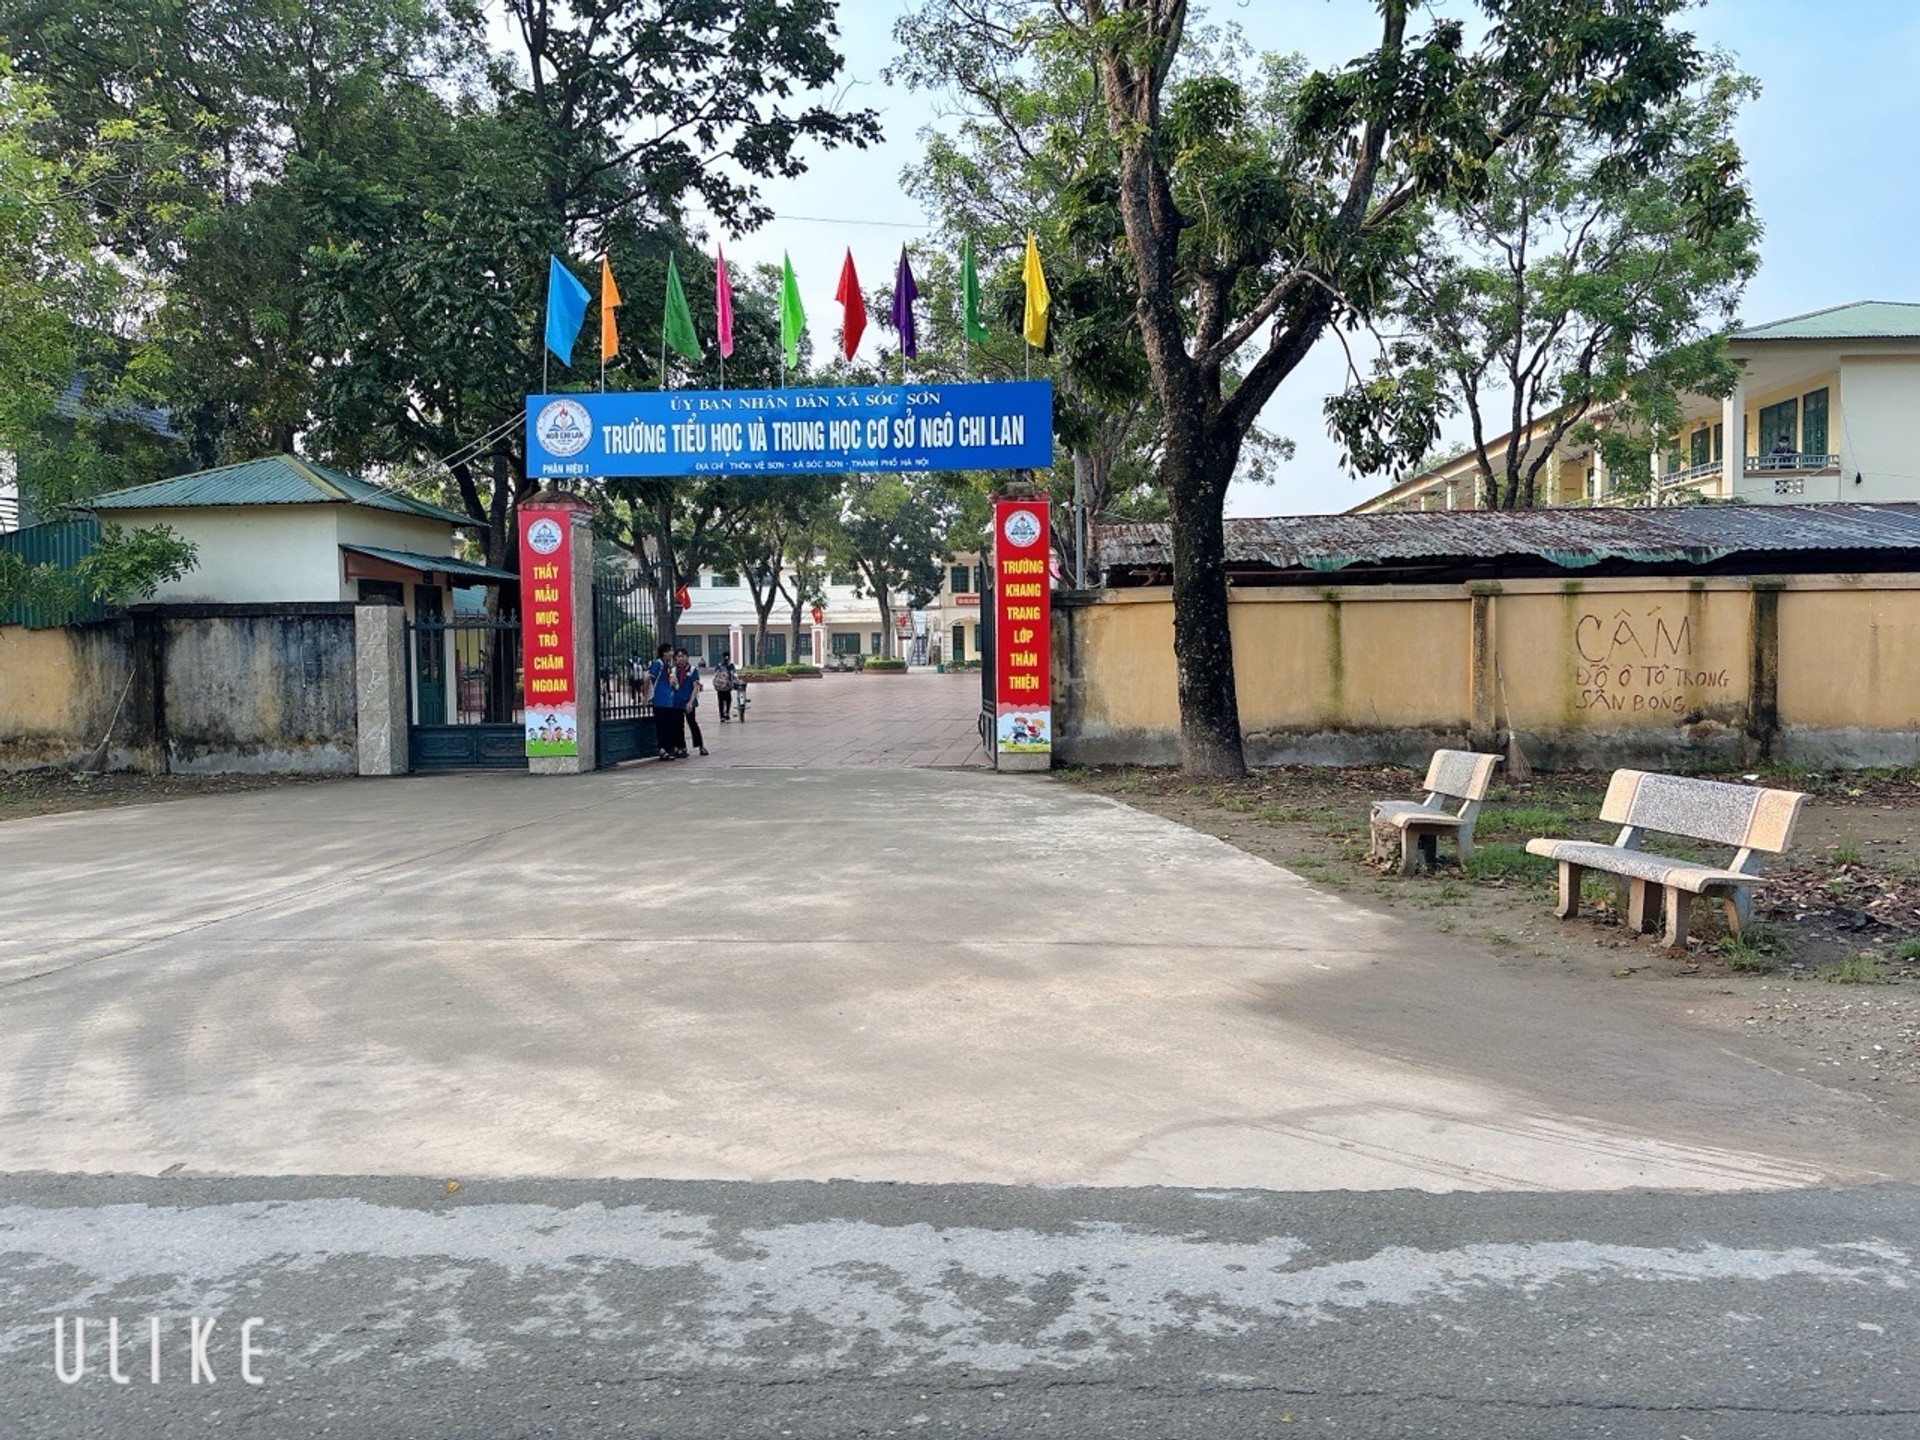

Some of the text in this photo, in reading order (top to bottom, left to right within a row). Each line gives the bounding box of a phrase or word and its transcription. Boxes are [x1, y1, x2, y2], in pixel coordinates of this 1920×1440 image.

[700, 398, 732, 411] BAN
[739, 394, 788, 409] NHÂN
[796, 393, 829, 408] DÂN
[836, 392, 859, 407] XÃ
[865, 391, 898, 406] SÓC
[906, 391, 940, 405] SƠN
[602, 417, 666, 454] TRƯỜNG
[671, 412, 706, 453] TIỂU
[711, 422, 742, 457] HỌC
[748, 416, 767, 452] VÀ
[772, 420, 825, 451] TRUNG
[829, 419, 861, 456] HỌC
[867, 416, 889, 450] CƠ
[893, 408, 916, 449] SỞ
[920, 411, 953, 448] NGÔ
[959, 415, 986, 447] CHI
[990, 415, 1024, 446] LAN
[543, 463, 564, 475] PHÂN
[1002, 557, 1044, 574] TRƯỜNG
[1005, 583, 1041, 597] KHANG
[536, 610, 559, 628] MỰC
[1007, 606, 1041, 620] TRANG
[1013, 627, 1034, 644] LỚP
[534, 654, 564, 670] CHĂM
[532, 679, 567, 693] NGOAN
[1008, 674, 1039, 692] THIỆN
[1674, 667, 1731, 688] TRONG
